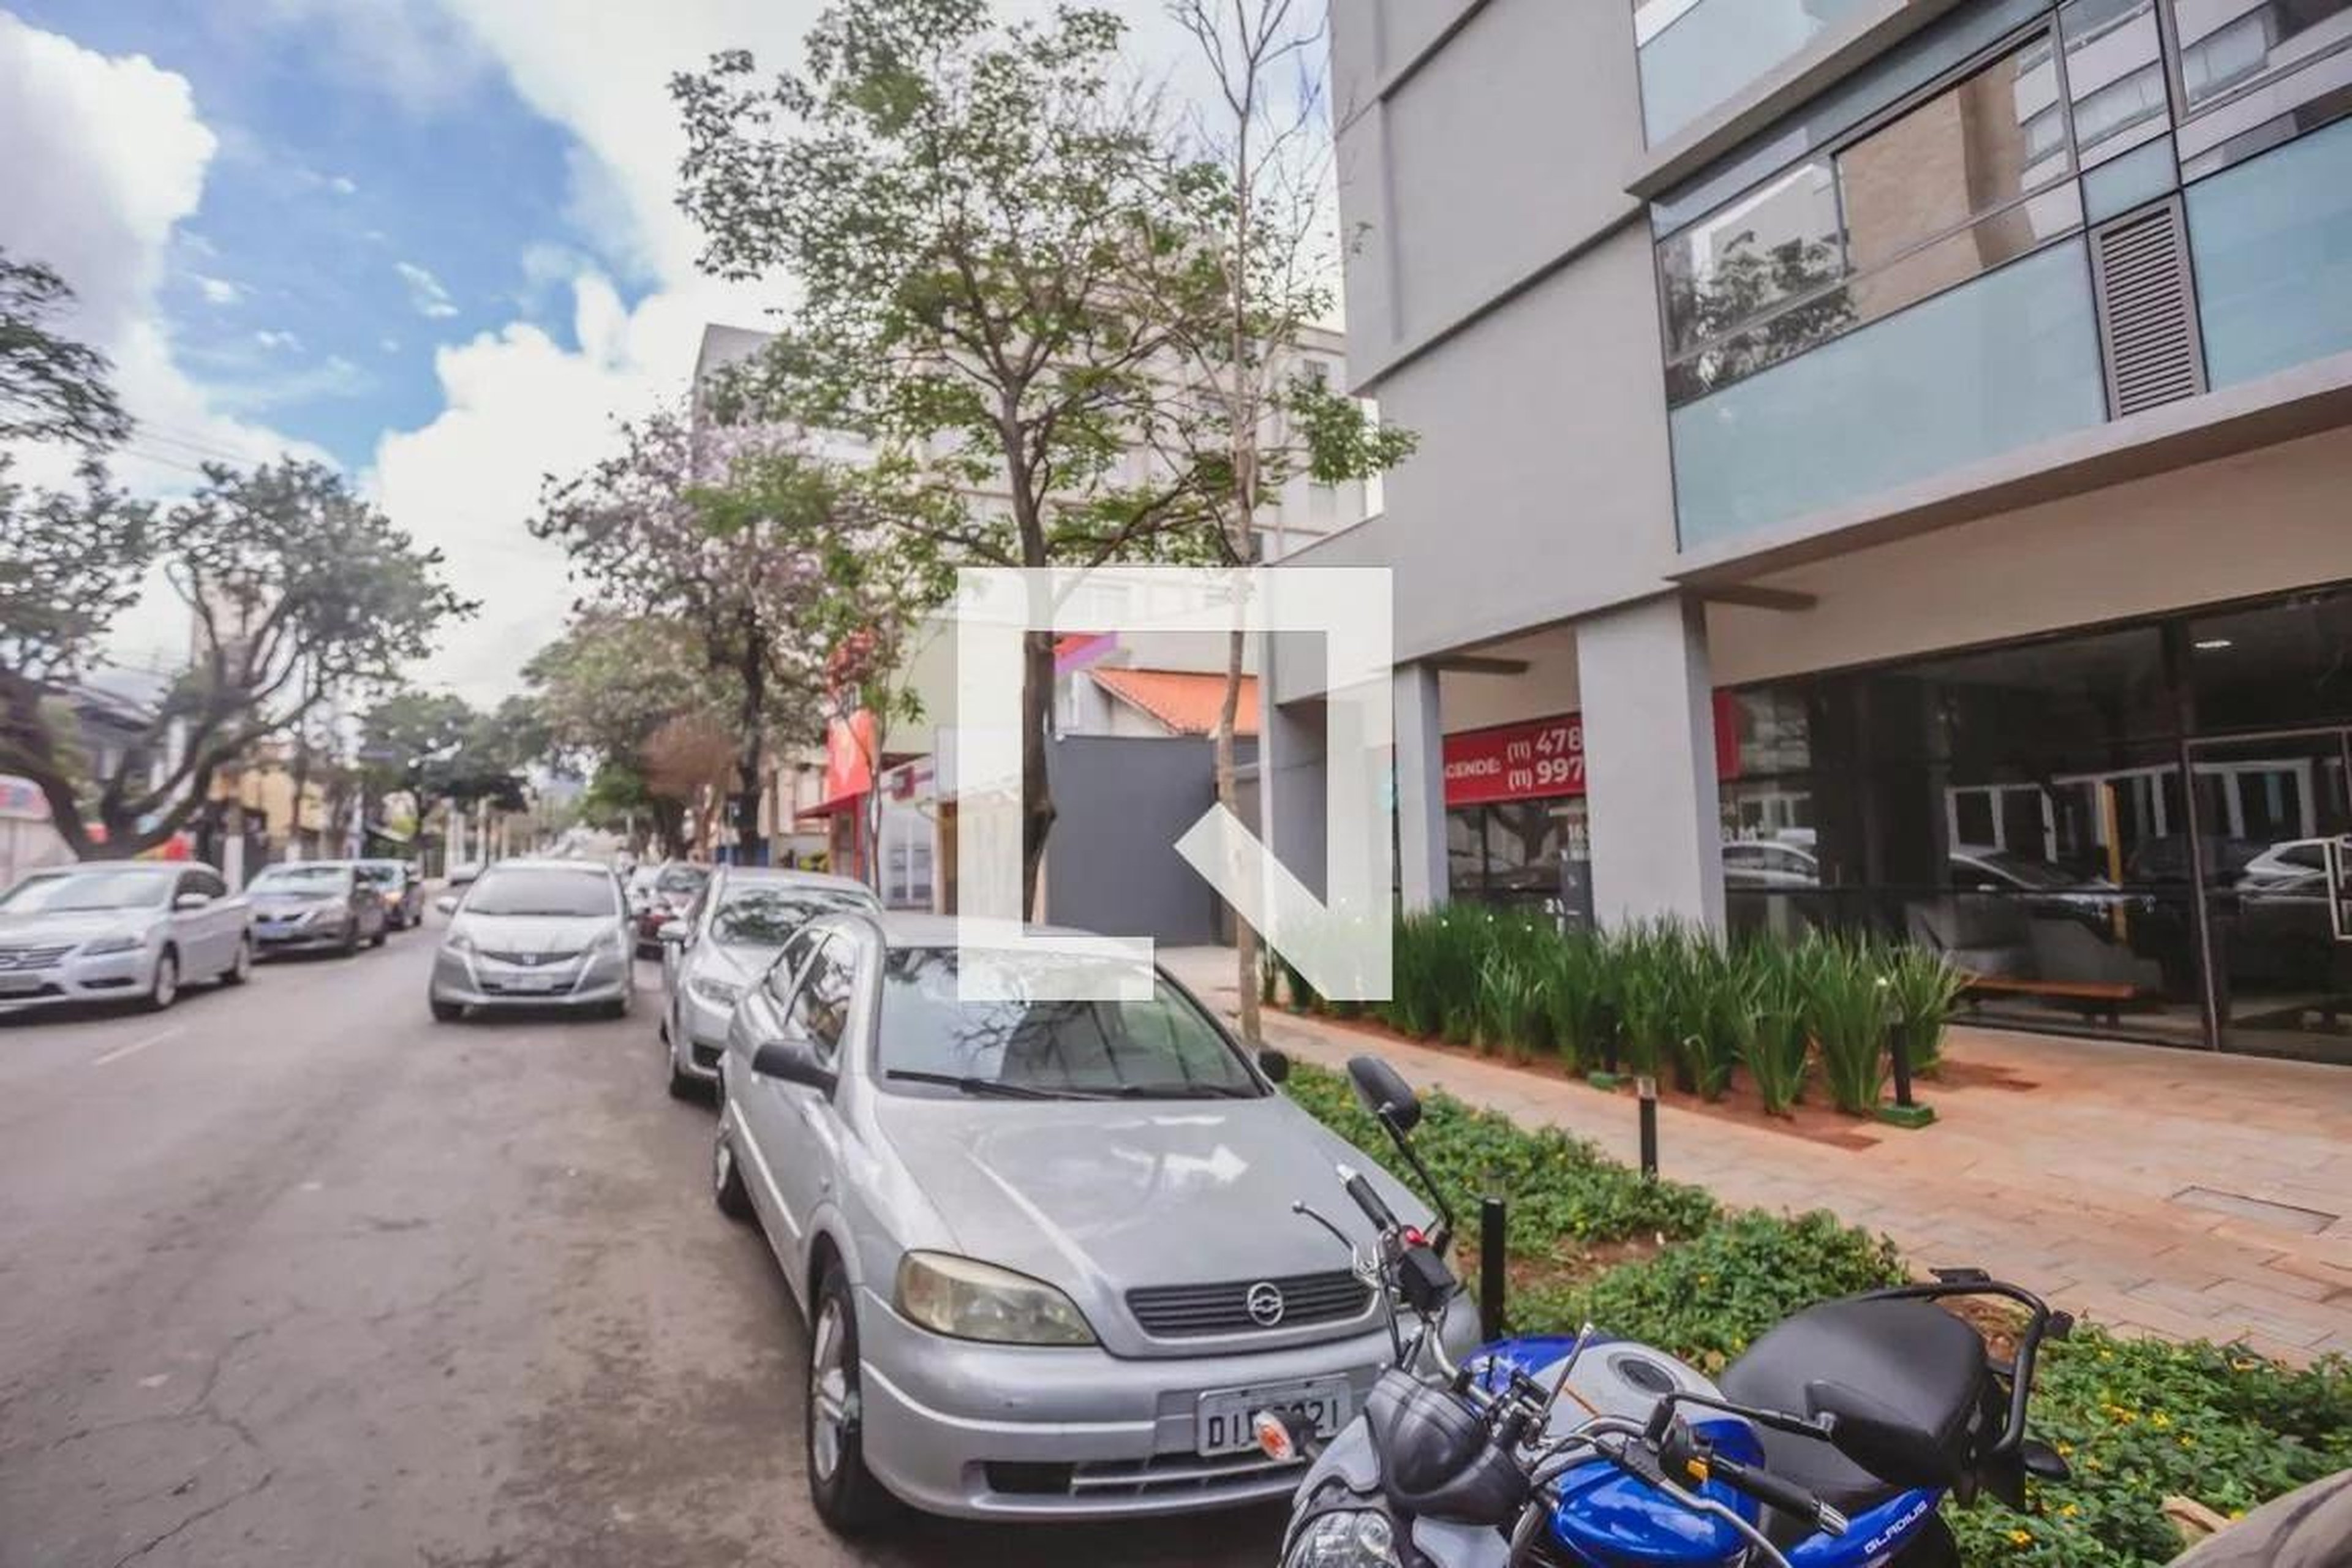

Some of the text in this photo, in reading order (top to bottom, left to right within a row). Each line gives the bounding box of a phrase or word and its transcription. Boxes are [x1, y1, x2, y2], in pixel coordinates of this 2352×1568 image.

[1507, 741, 1531, 763] (11)
[1508, 756, 1583, 791] (11) 997
[1863, 1500, 1928, 1554] GLADIUS
